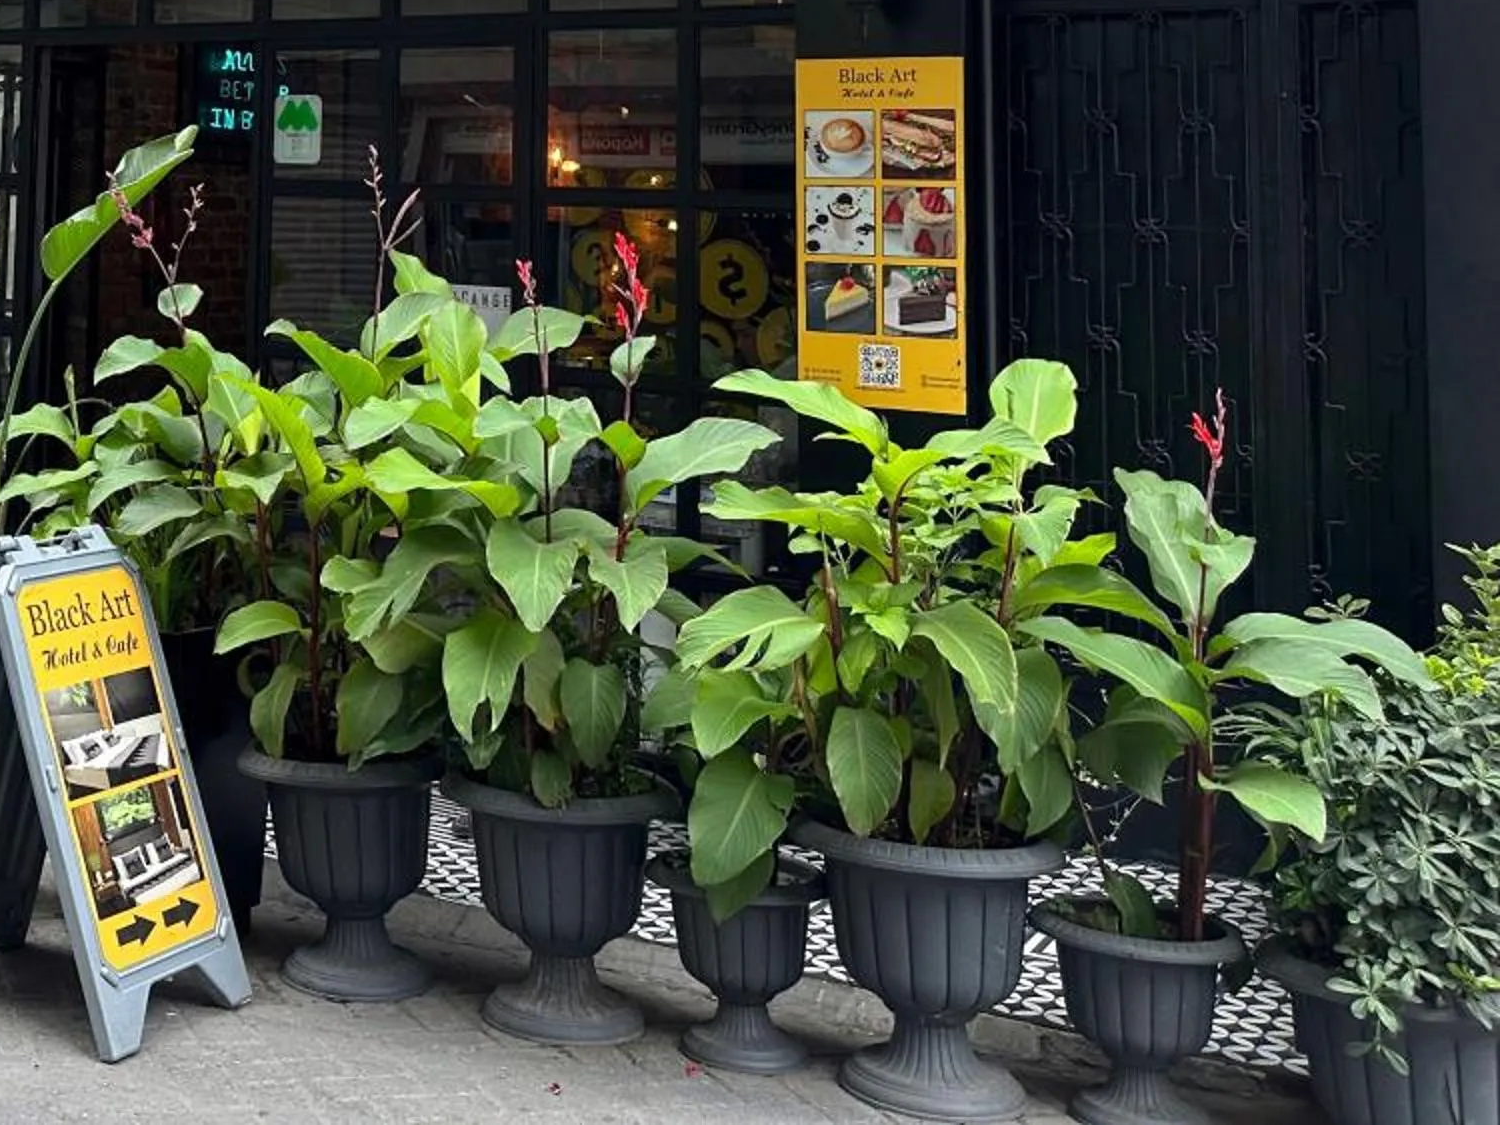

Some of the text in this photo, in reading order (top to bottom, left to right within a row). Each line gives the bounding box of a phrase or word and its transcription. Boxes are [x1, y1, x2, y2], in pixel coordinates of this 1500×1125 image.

[838, 68, 917, 84] Black Art
[28, 588, 136, 637] Black Art
[42, 631, 140, 670] Hotel & Cafe
